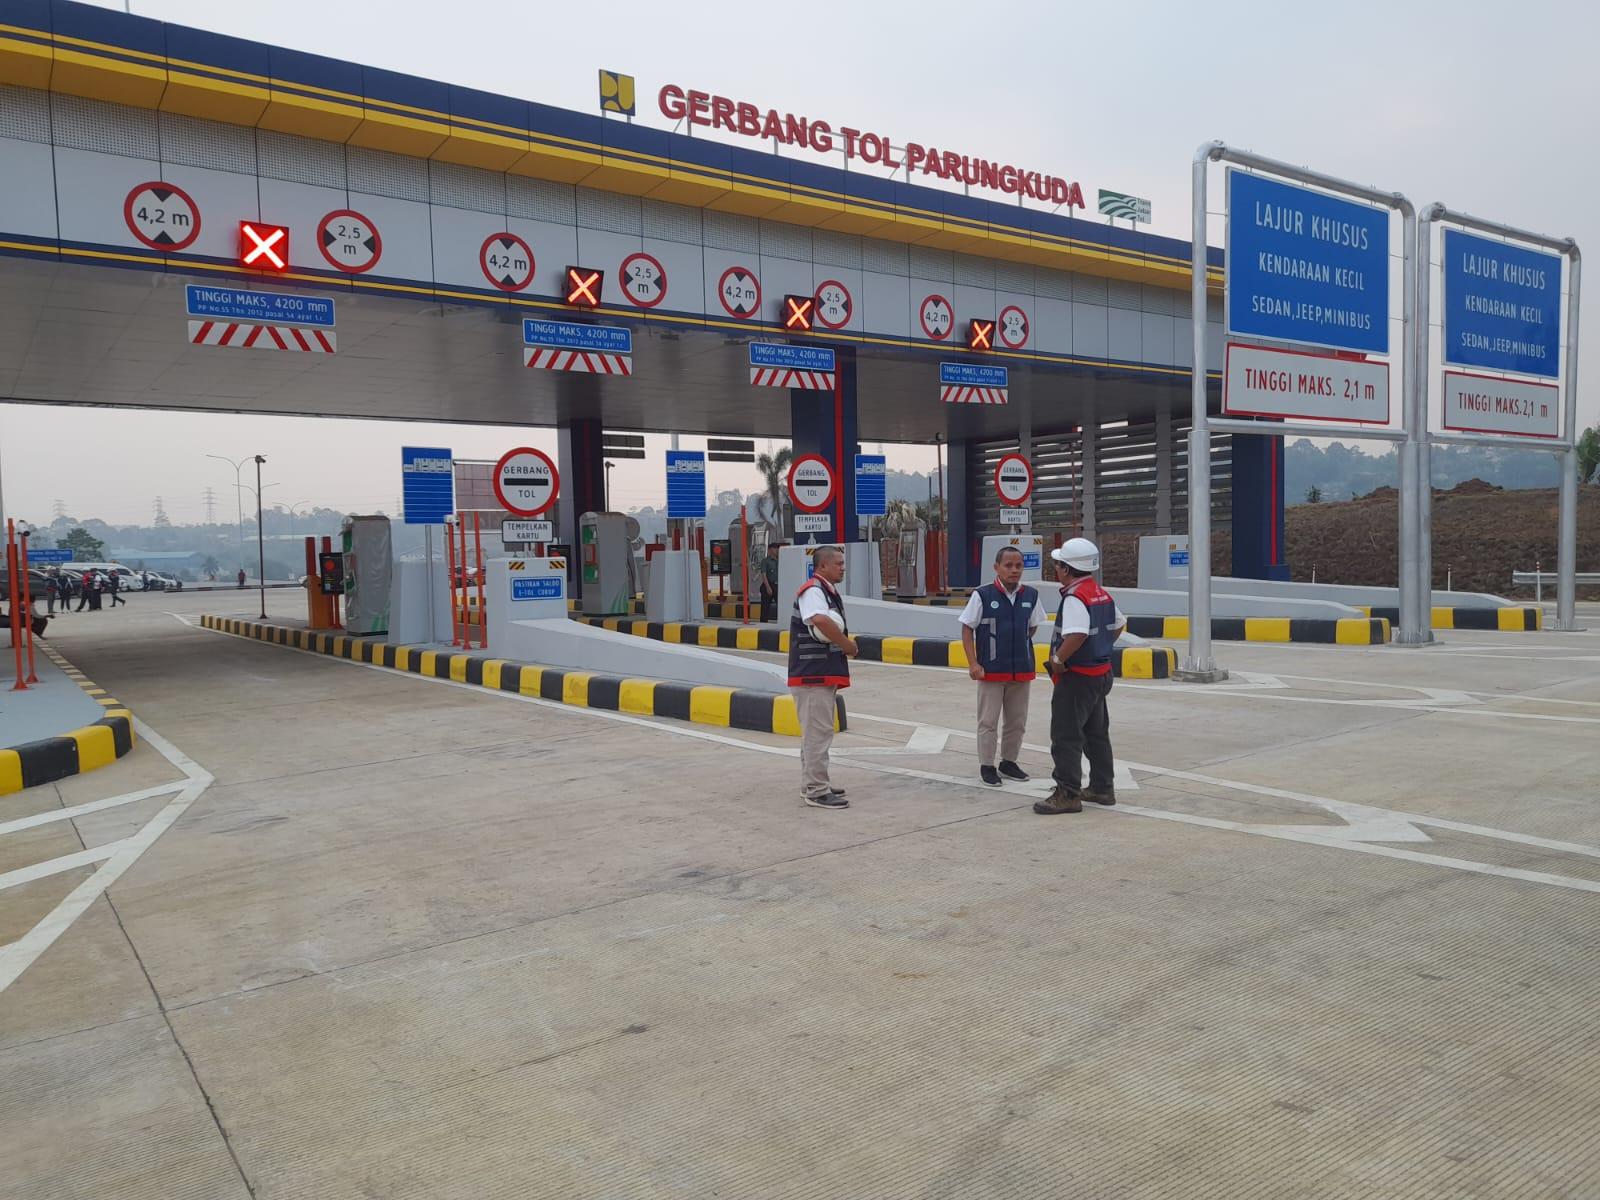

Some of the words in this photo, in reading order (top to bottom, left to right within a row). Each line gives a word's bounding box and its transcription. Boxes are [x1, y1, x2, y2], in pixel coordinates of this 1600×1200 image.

[658, 84, 833, 152] GERBANG
[841, 127, 900, 168] TOL
[906, 142, 1086, 209] PARUNGKUDA
[137, 208, 165, 224] 4,2
[173, 212, 189, 226] m
[338, 226, 360, 239] 2,5
[1256, 201, 1303, 234] LAJUR
[1312, 216, 1368, 250] KHUSUS
[344, 244, 356, 254] m
[490, 254, 510, 269] 4,2
[515, 259, 526, 270] m
[635, 267, 651, 279] 2,5
[1259, 252, 1330, 283] KENDARAAN
[1336, 268, 1364, 290] KECIL
[1463, 252, 1497, 279] LAJUR
[1504, 262, 1545, 290] KHUSUS
[638, 284, 648, 293] m
[726, 286, 741, 298] 4,2
[745, 290, 754, 299] m
[195, 290, 231, 303] TINGGI
[275, 298, 302, 310] 4200
[308, 303, 327, 312] mm
[827, 292, 840, 303] 2,5
[1466, 294, 1516, 320] KENDARAAN
[1521, 306, 1542, 324] KECIL
[926, 312, 938, 323] 4,2
[941, 314, 948, 322] m
[530, 323, 555, 334] TINGGI
[587, 329, 608, 339] 4200
[611, 332, 626, 340] mm
[755, 346, 775, 355] TINGGI
[800, 350, 816, 359] 4200
[1246, 368, 1291, 392] TINGGI
[1299, 374, 1336, 396] MAKS.
[1344, 379, 1358, 401] 2,1
[1365, 384, 1374, 400] m
[1458, 392, 1491, 412] TINGGI
[1540, 404, 1548, 417] m
[504, 466, 549, 475] GERBANG
[518, 490, 535, 498] TOL
